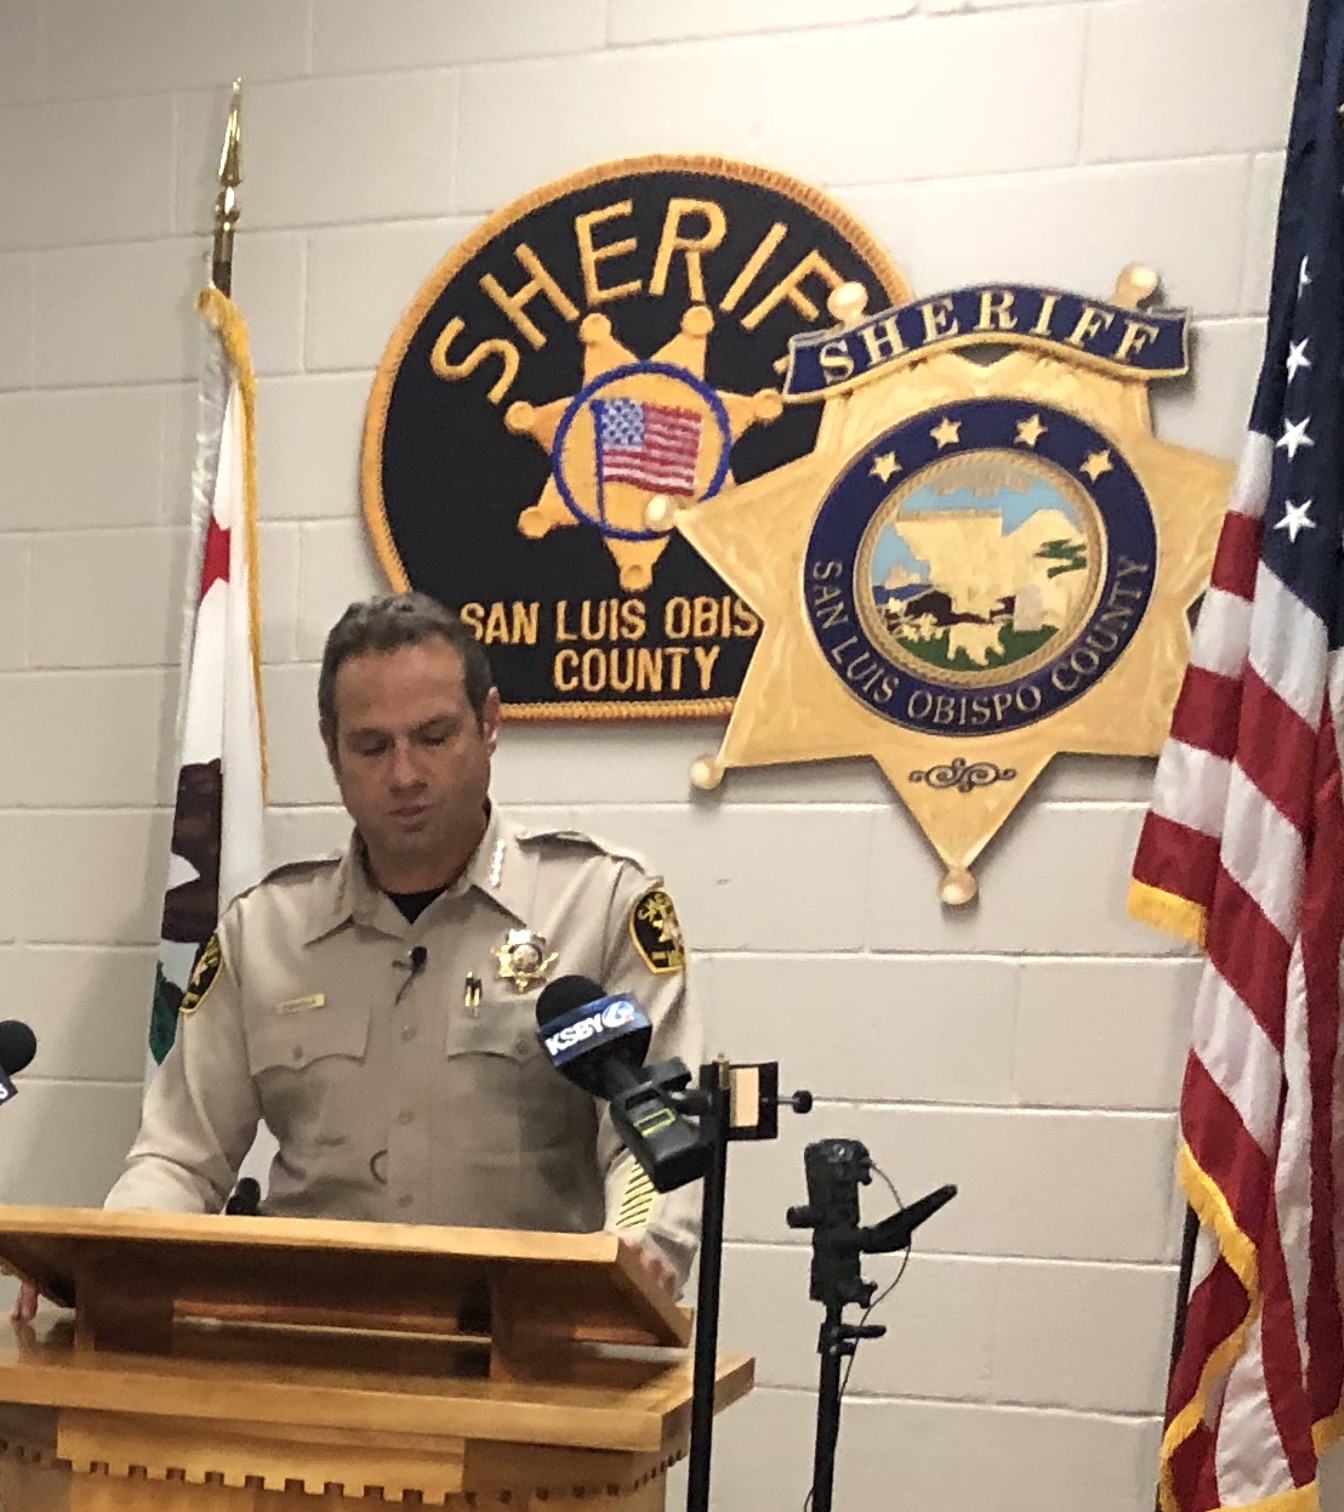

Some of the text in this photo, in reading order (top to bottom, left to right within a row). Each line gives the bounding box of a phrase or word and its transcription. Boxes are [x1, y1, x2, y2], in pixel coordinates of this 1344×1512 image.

[430, 197, 847, 405] SHERIF
[819, 290, 1160, 384] SHERIFF
[460, 601, 541, 645] SAN
[556, 598, 647, 642] LUIS
[812, 554, 1149, 726] SAN LUIS OBISPO COUNTY
[553, 645, 721, 692] COUNTY
[544, 1012, 605, 1056] KSBY
